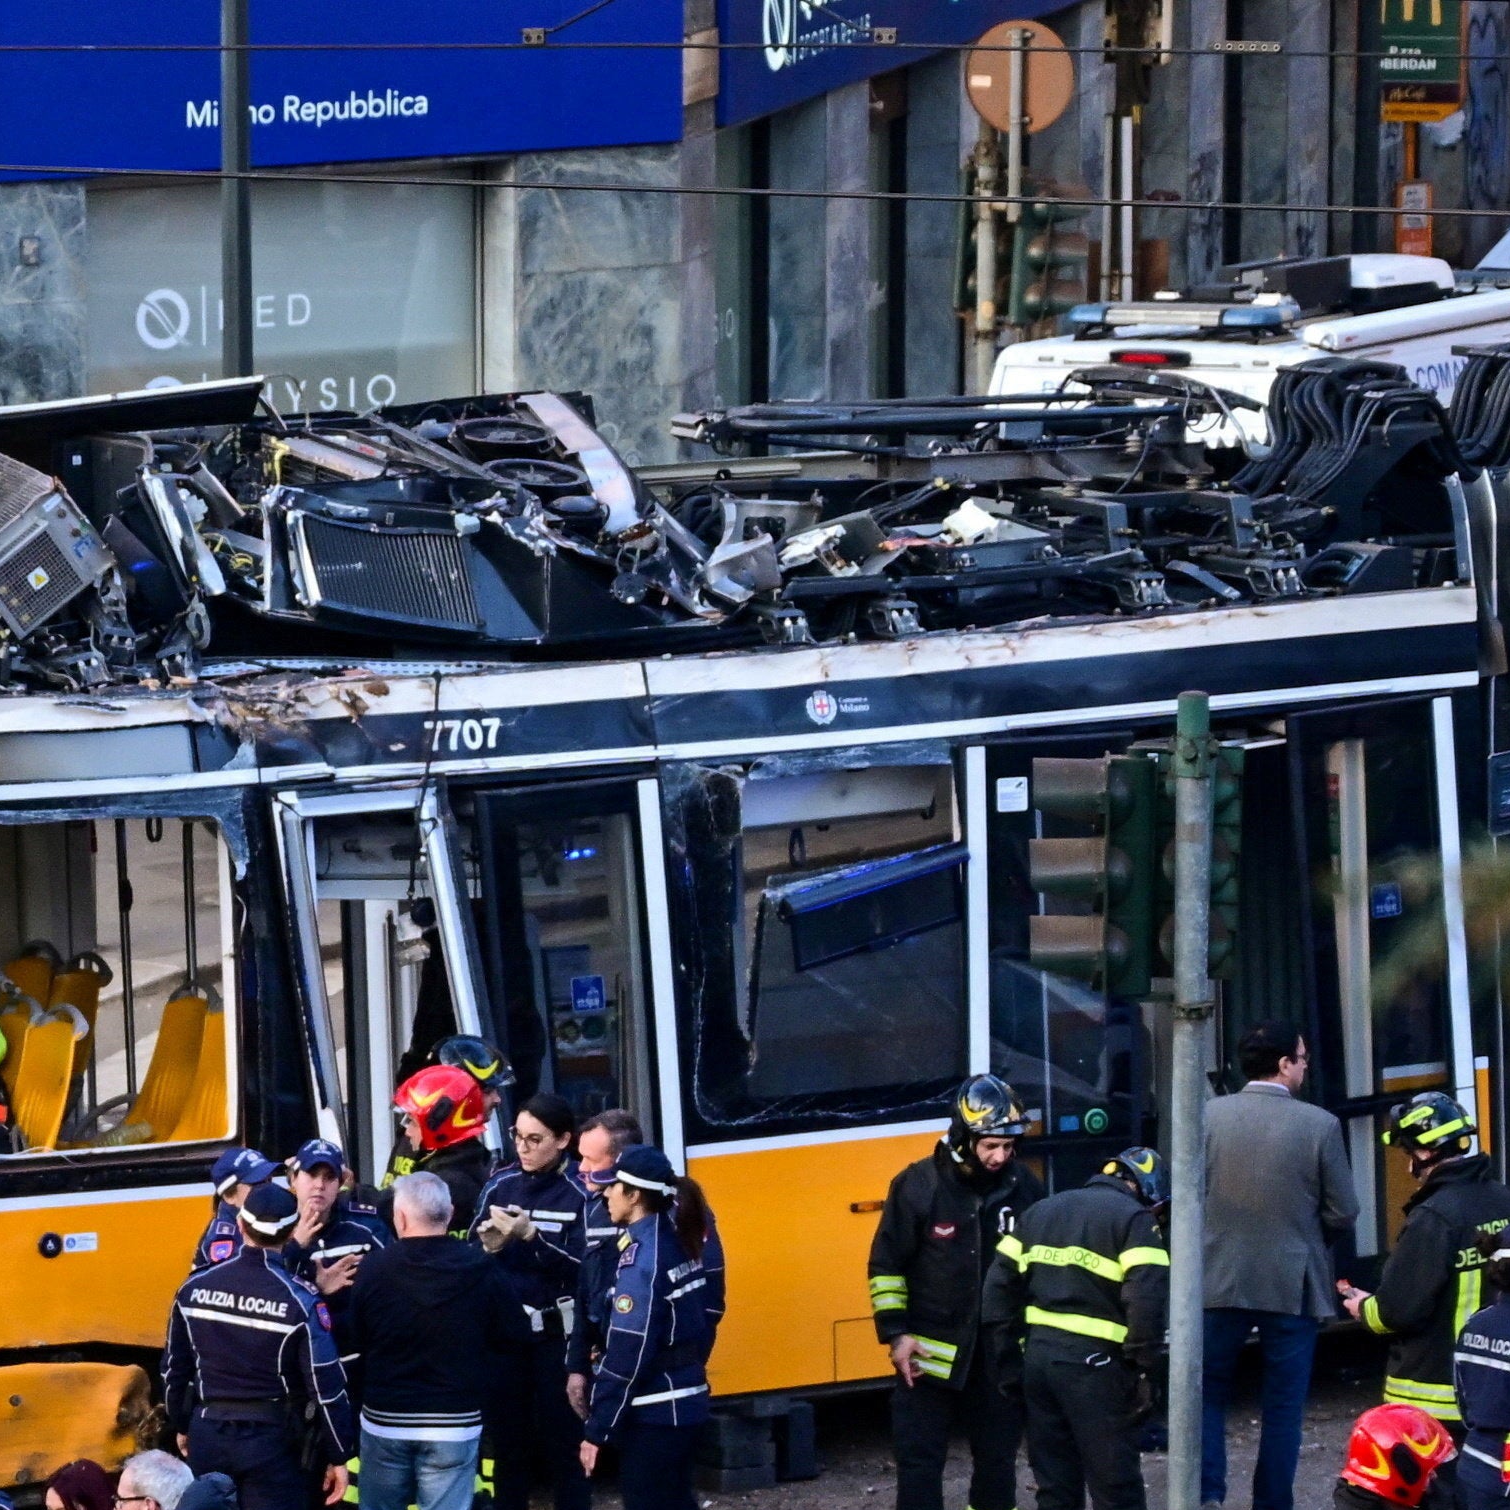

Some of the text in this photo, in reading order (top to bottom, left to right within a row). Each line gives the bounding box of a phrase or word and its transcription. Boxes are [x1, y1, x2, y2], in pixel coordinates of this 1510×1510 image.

[186, 88, 429, 128] Mino Repubblica
[217, 293, 312, 331] ED
[261, 374, 397, 413] YSIO
[838, 703, 871, 713] Milano
[423, 716, 501, 752] 7707
[190, 1288, 289, 1319] POLIZIA LOCALE
[1463, 1333, 1490, 1350] OLIZIA
